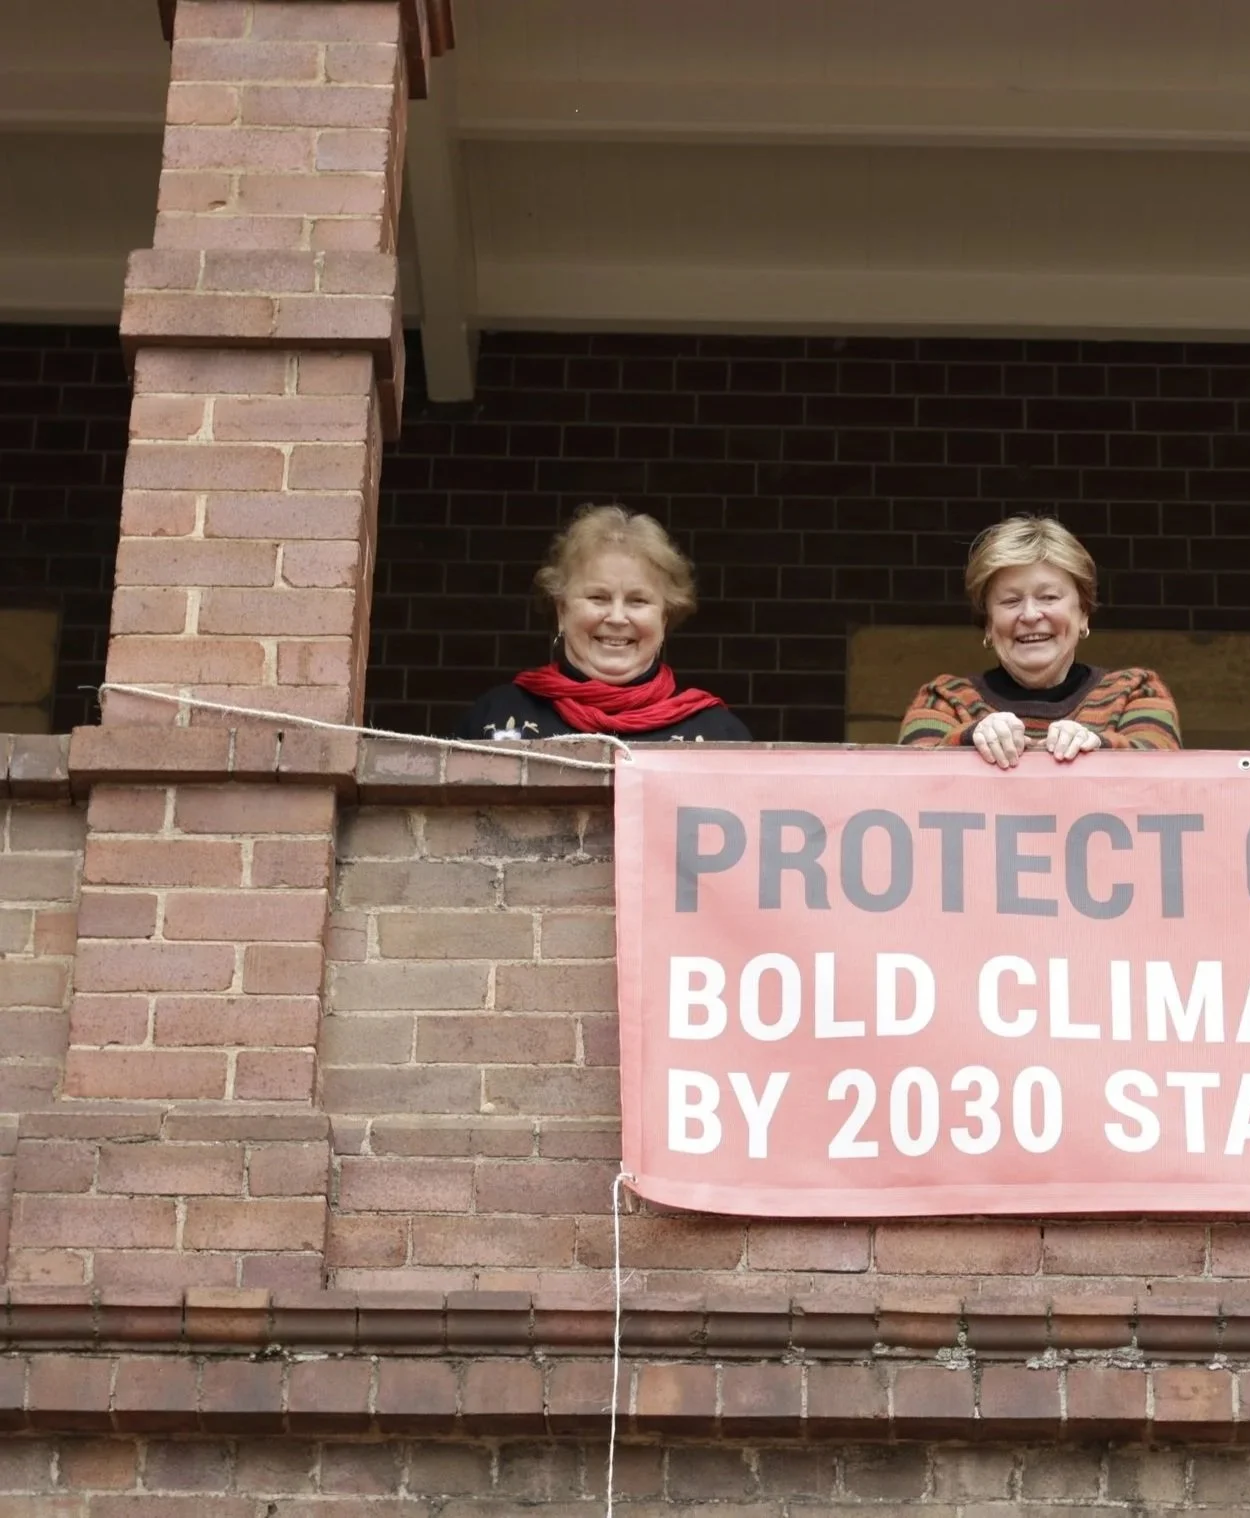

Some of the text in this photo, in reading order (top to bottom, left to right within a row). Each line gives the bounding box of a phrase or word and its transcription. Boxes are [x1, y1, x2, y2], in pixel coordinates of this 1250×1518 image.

[675, 806, 1204, 919] PROTECT
[668, 952, 936, 1041] BOLD
[668, 1068, 791, 1159] BY
[827, 1066, 1063, 1159] 2030
